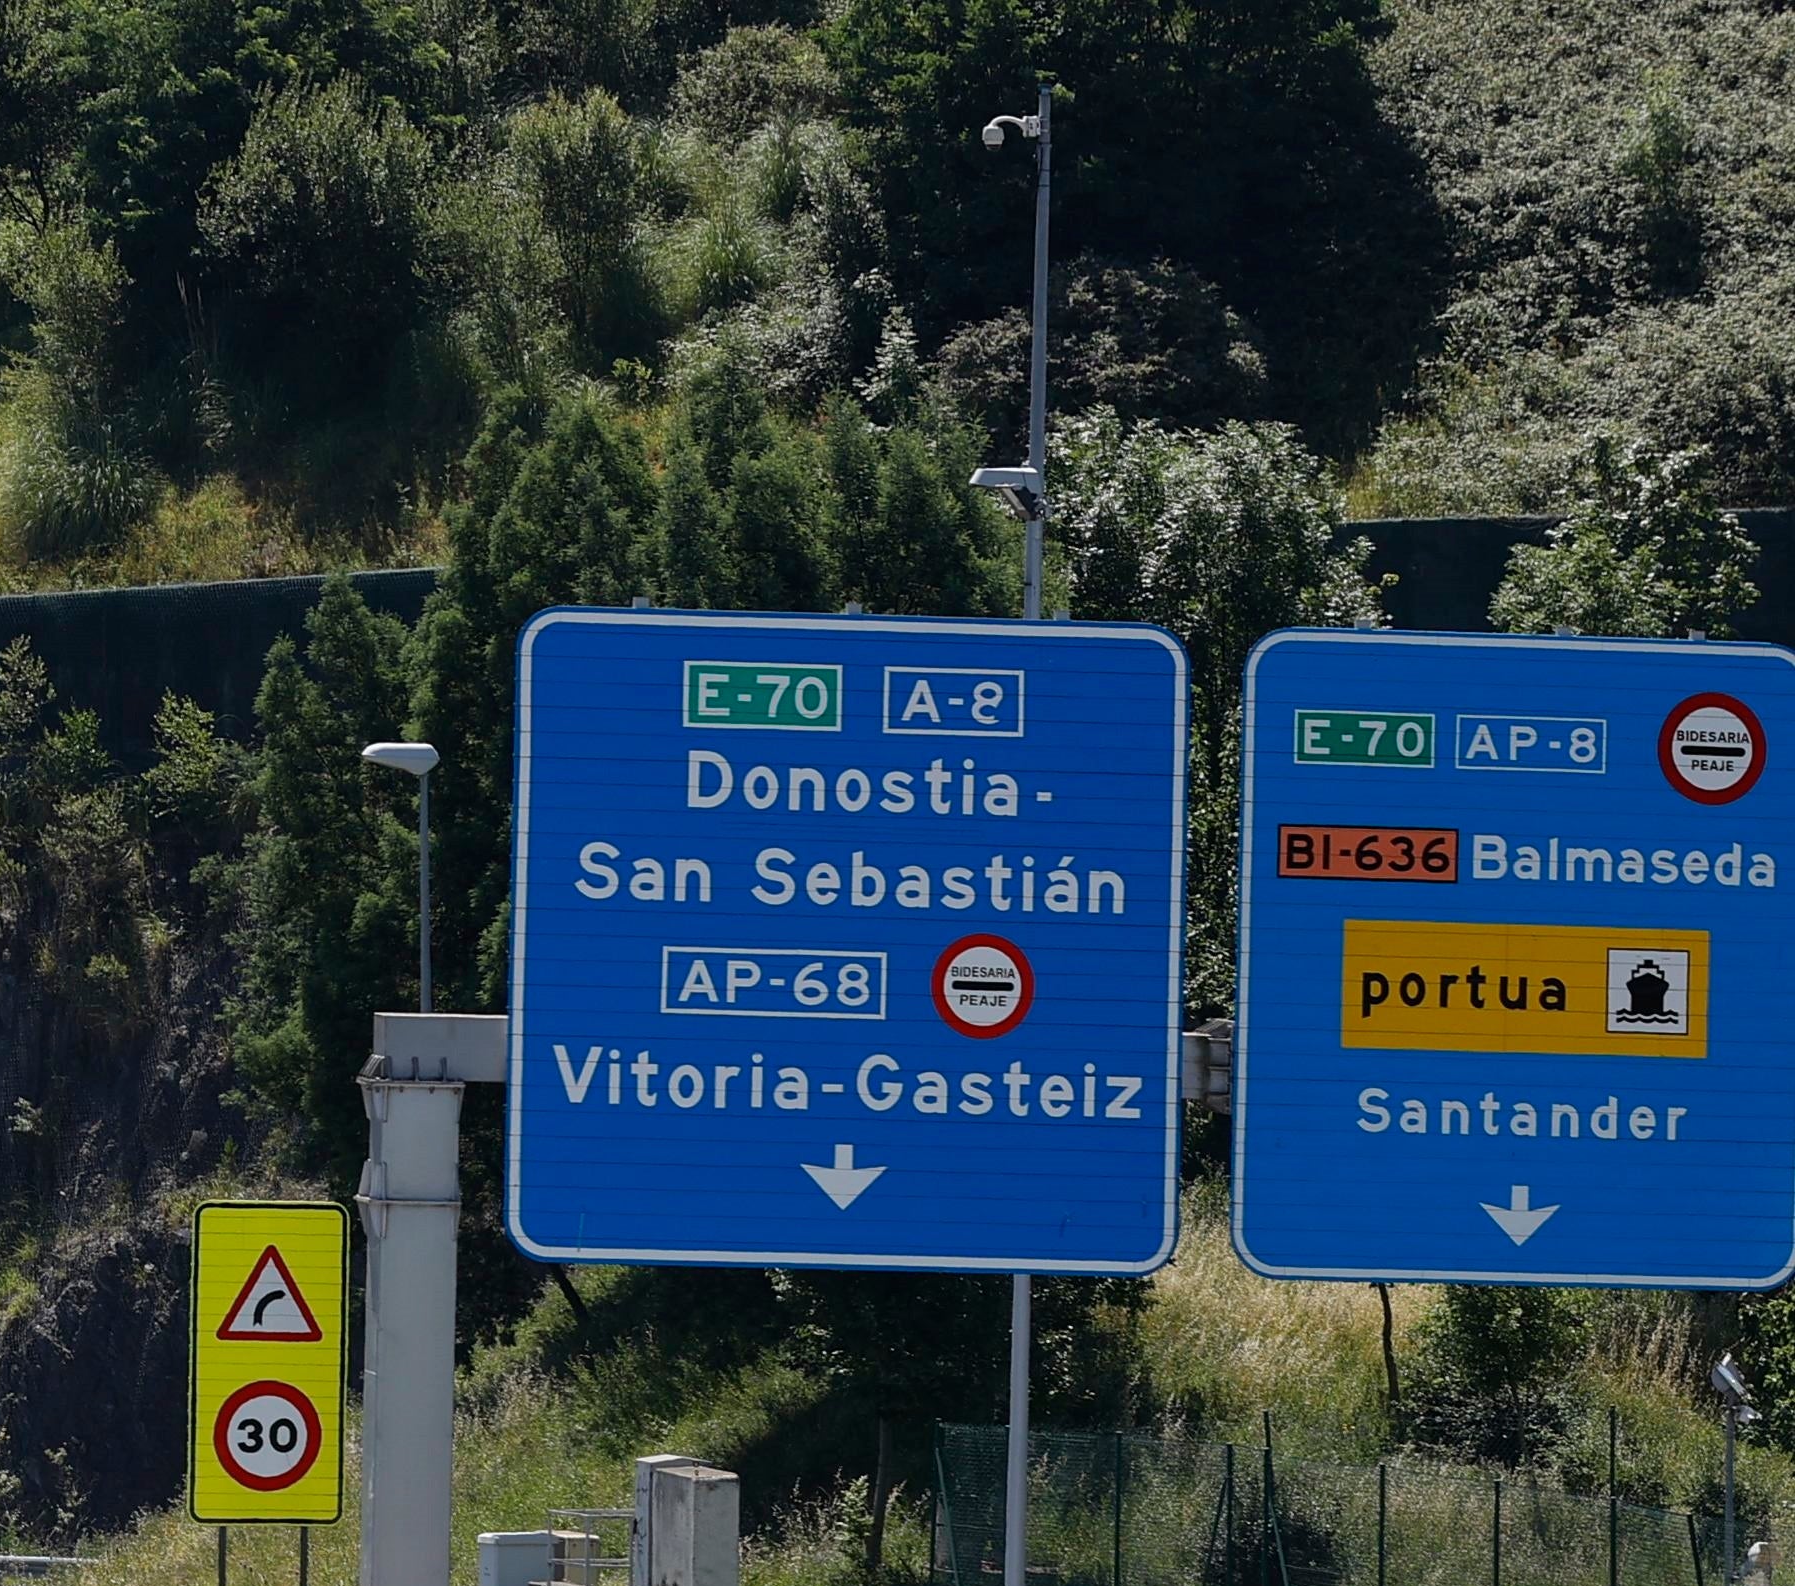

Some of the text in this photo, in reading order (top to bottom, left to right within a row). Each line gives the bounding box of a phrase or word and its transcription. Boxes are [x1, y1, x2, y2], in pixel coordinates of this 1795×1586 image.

[697, 673, 1003, 724] E-70 A-8
[1303, 720, 1597, 764] E-70 AP-8
[1675, 729, 1750, 745] BIDESARIA
[687, 750, 1052, 817] Donostia-
[1691, 759, 1735, 774] PEAJE
[574, 842, 1125, 914] San Sebastián
[1286, 833, 1776, 888] BI-636 Balmaseda
[678, 959, 870, 1007] AP-68
[951, 965, 1016, 980] BIDESARIA
[1361, 965, 1568, 1017] portua
[959, 993, 1007, 1008] PEAJE
[553, 1044, 1143, 1119] Vitoria-Gasteiz
[1356, 1087, 1687, 1141] Santander
[236, 1416, 299, 1455] 30
